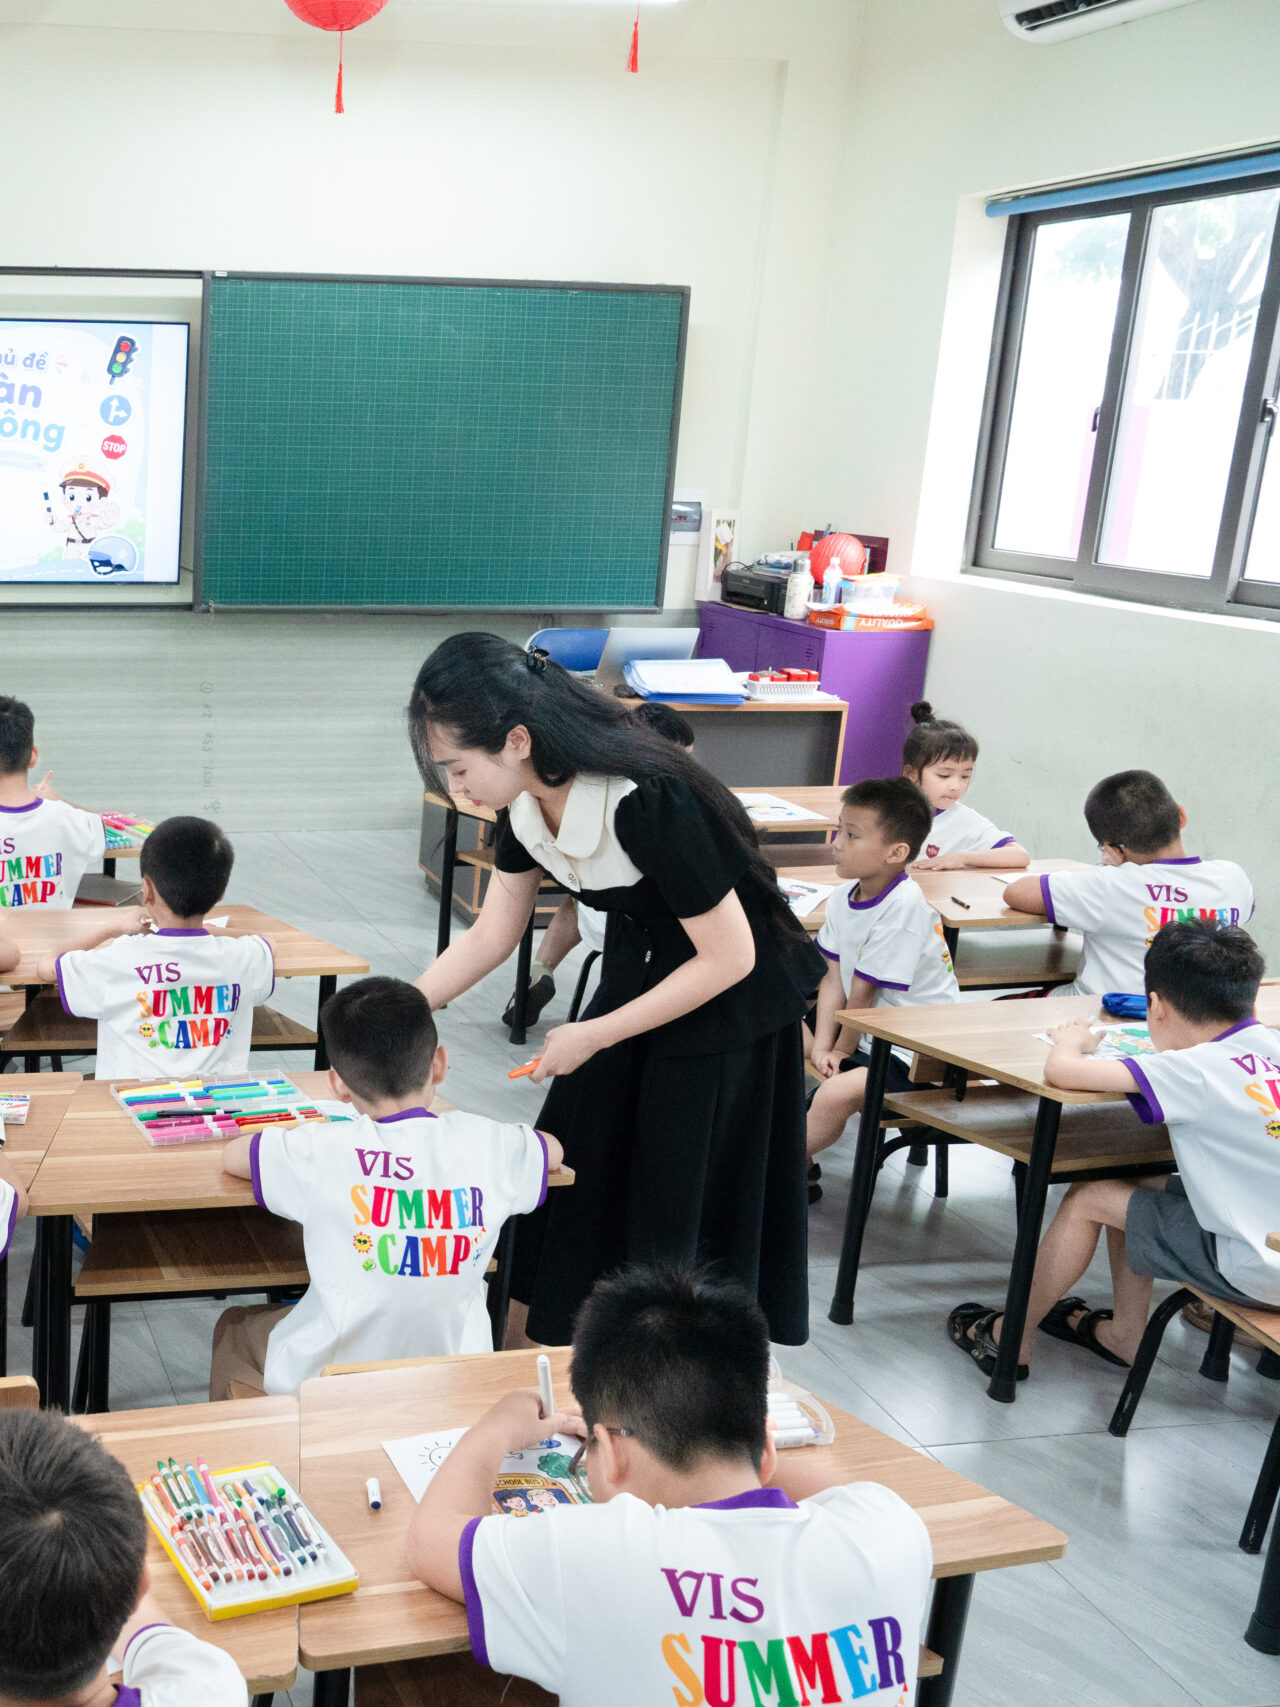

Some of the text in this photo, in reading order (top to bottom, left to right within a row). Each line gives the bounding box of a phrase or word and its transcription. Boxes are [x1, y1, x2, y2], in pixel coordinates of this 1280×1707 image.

[22, 351, 48, 371] đề
[102, 440, 126, 453] STOP
[859, 618, 904, 627] QUALITY
[1145, 883, 1189, 903] VIS
[134, 962, 182, 985] VIS
[136, 983, 241, 1019] SUMMER
[157, 1017, 229, 1049] CAMP
[354, 1148, 415, 1181] VIS
[350, 1184, 484, 1230] SUMMER
[377, 1233, 471, 1278] CAMP
[660, 1567, 765, 1624] VIS
[661, 1616, 906, 1707] SUMMER
